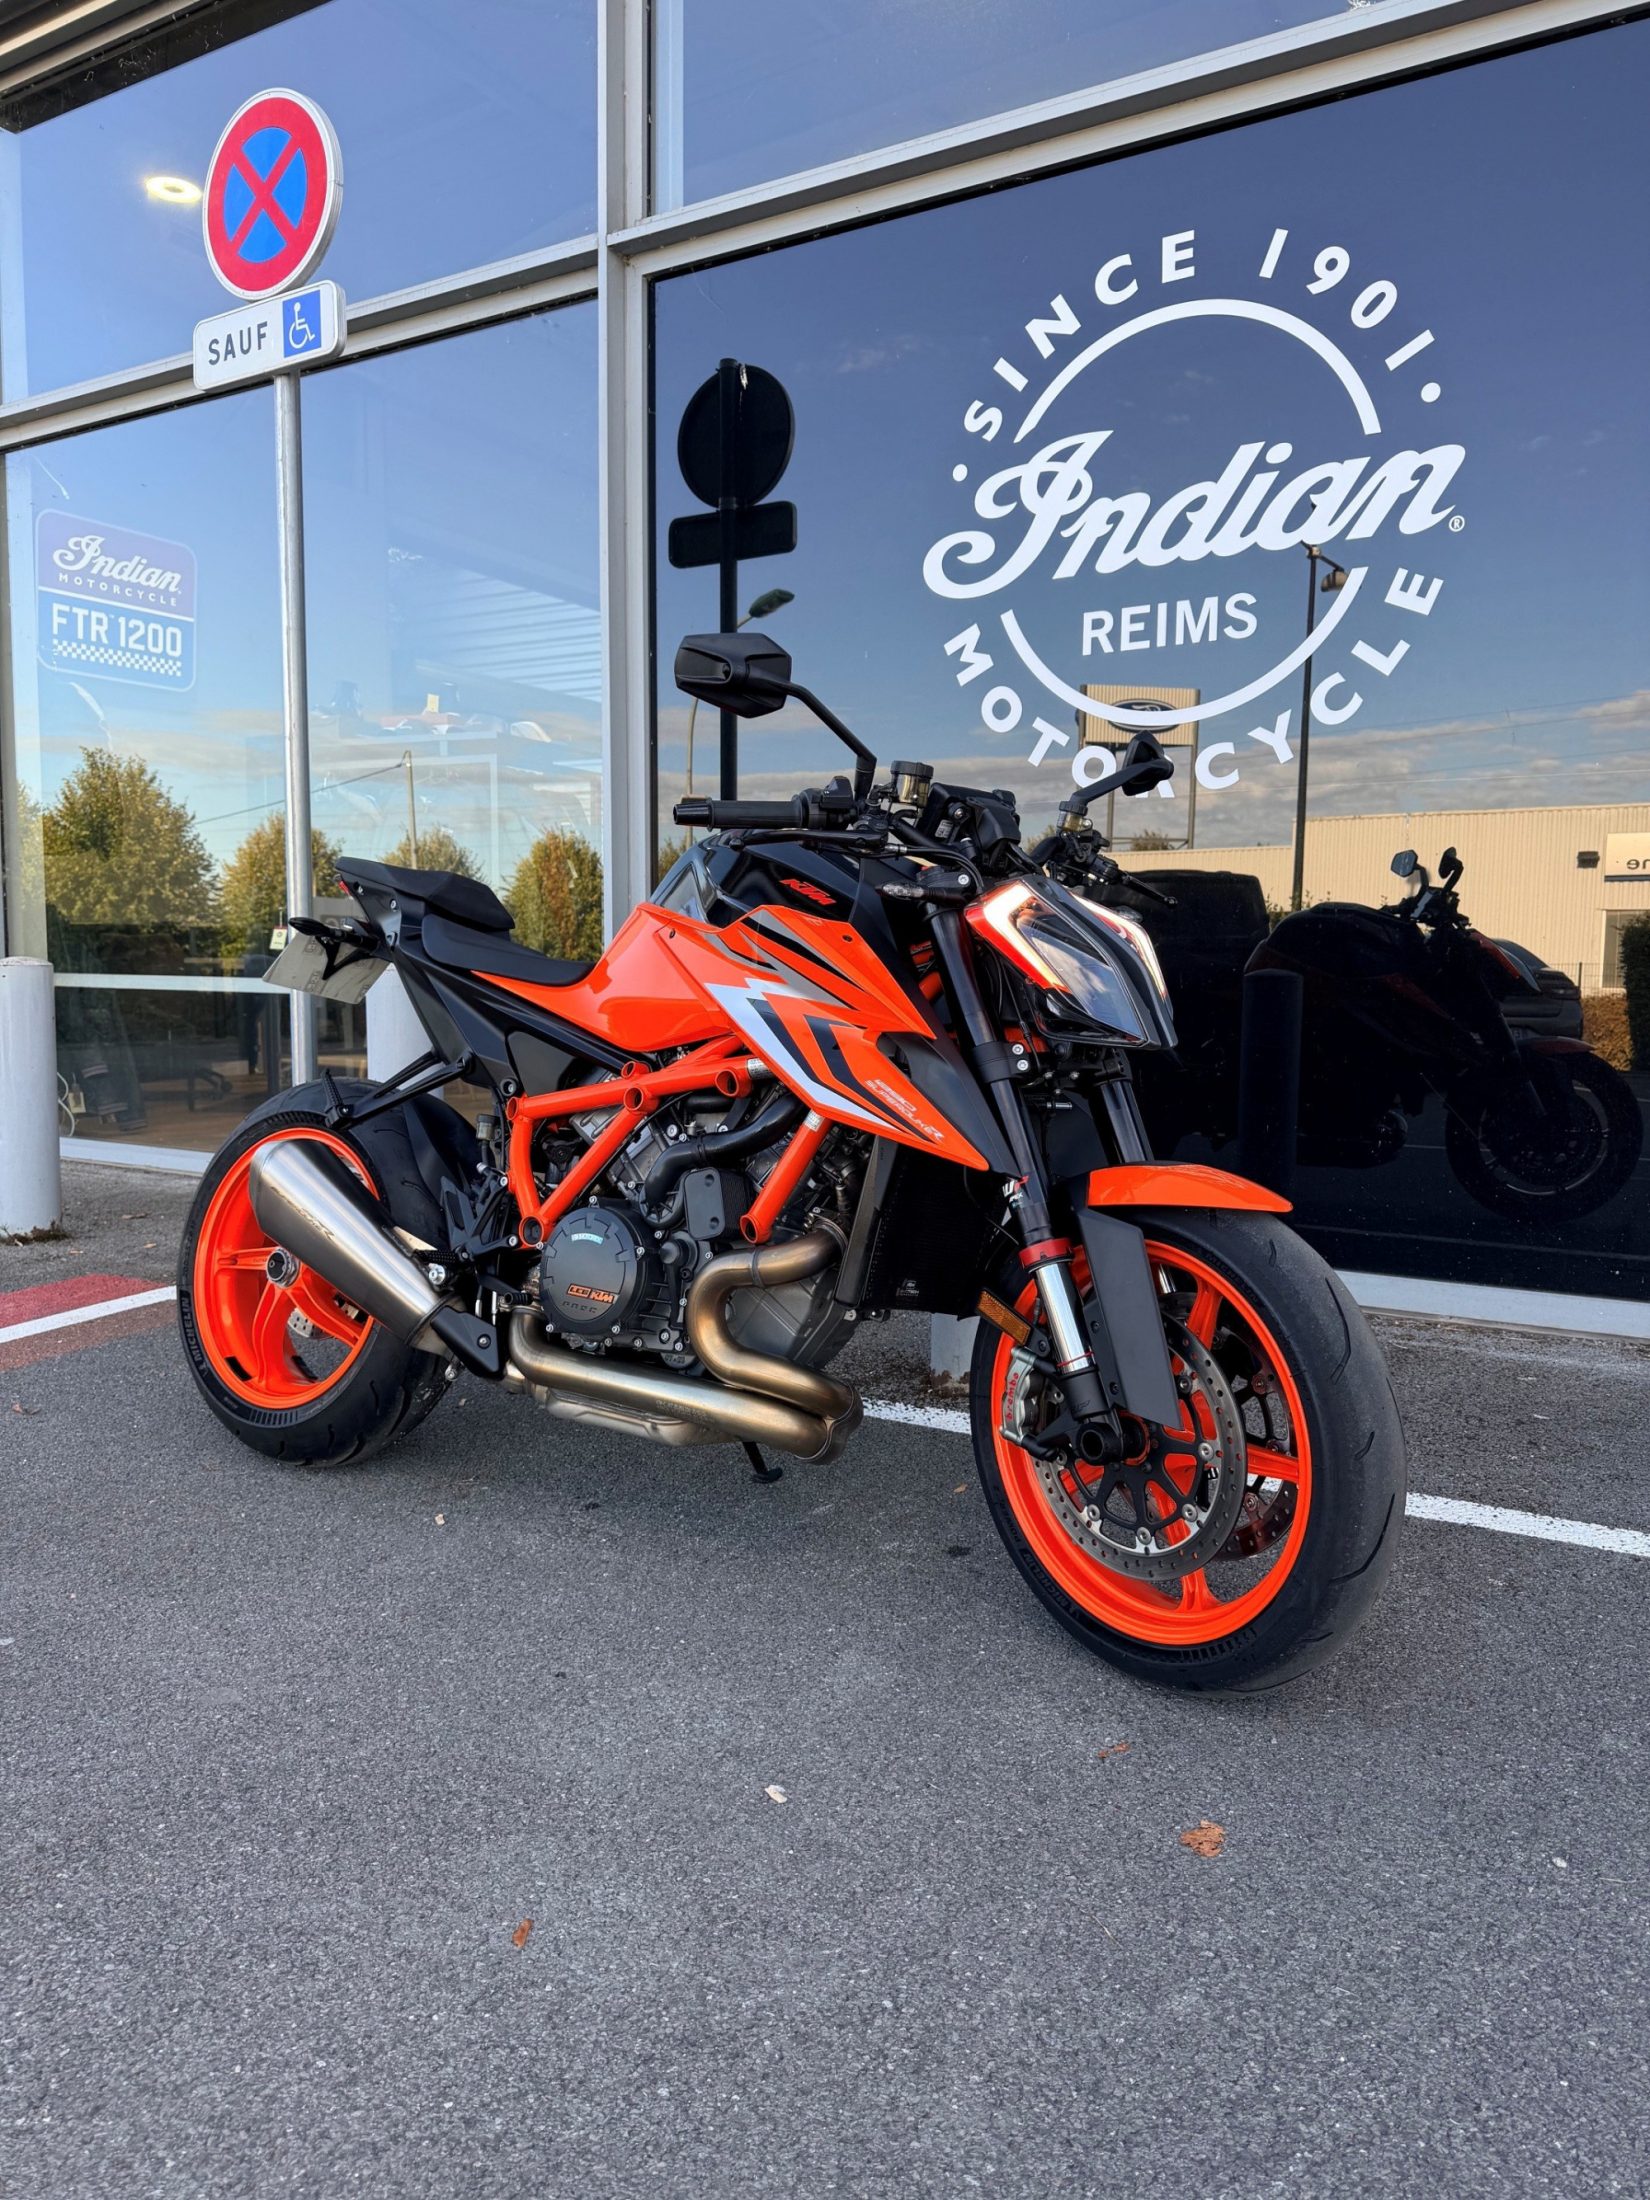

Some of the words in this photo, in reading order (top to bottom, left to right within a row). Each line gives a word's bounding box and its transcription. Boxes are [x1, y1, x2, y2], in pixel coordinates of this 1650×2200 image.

[208, 320, 268, 366] SAUF
[963, 229, 1196, 441] SINCE
[1258, 228, 1435, 372] 1901
[923, 430, 1466, 600] Indian
[53, 535, 182, 593] Indian
[58, 572, 177, 607] MOTORCYCLE
[52, 602, 109, 645] FTR
[118, 616, 182, 657] 1200
[1081, 592, 1258, 657] REIMS
[779, 878, 837, 906] KTM
[1005, 1371, 1020, 1422] brembo
